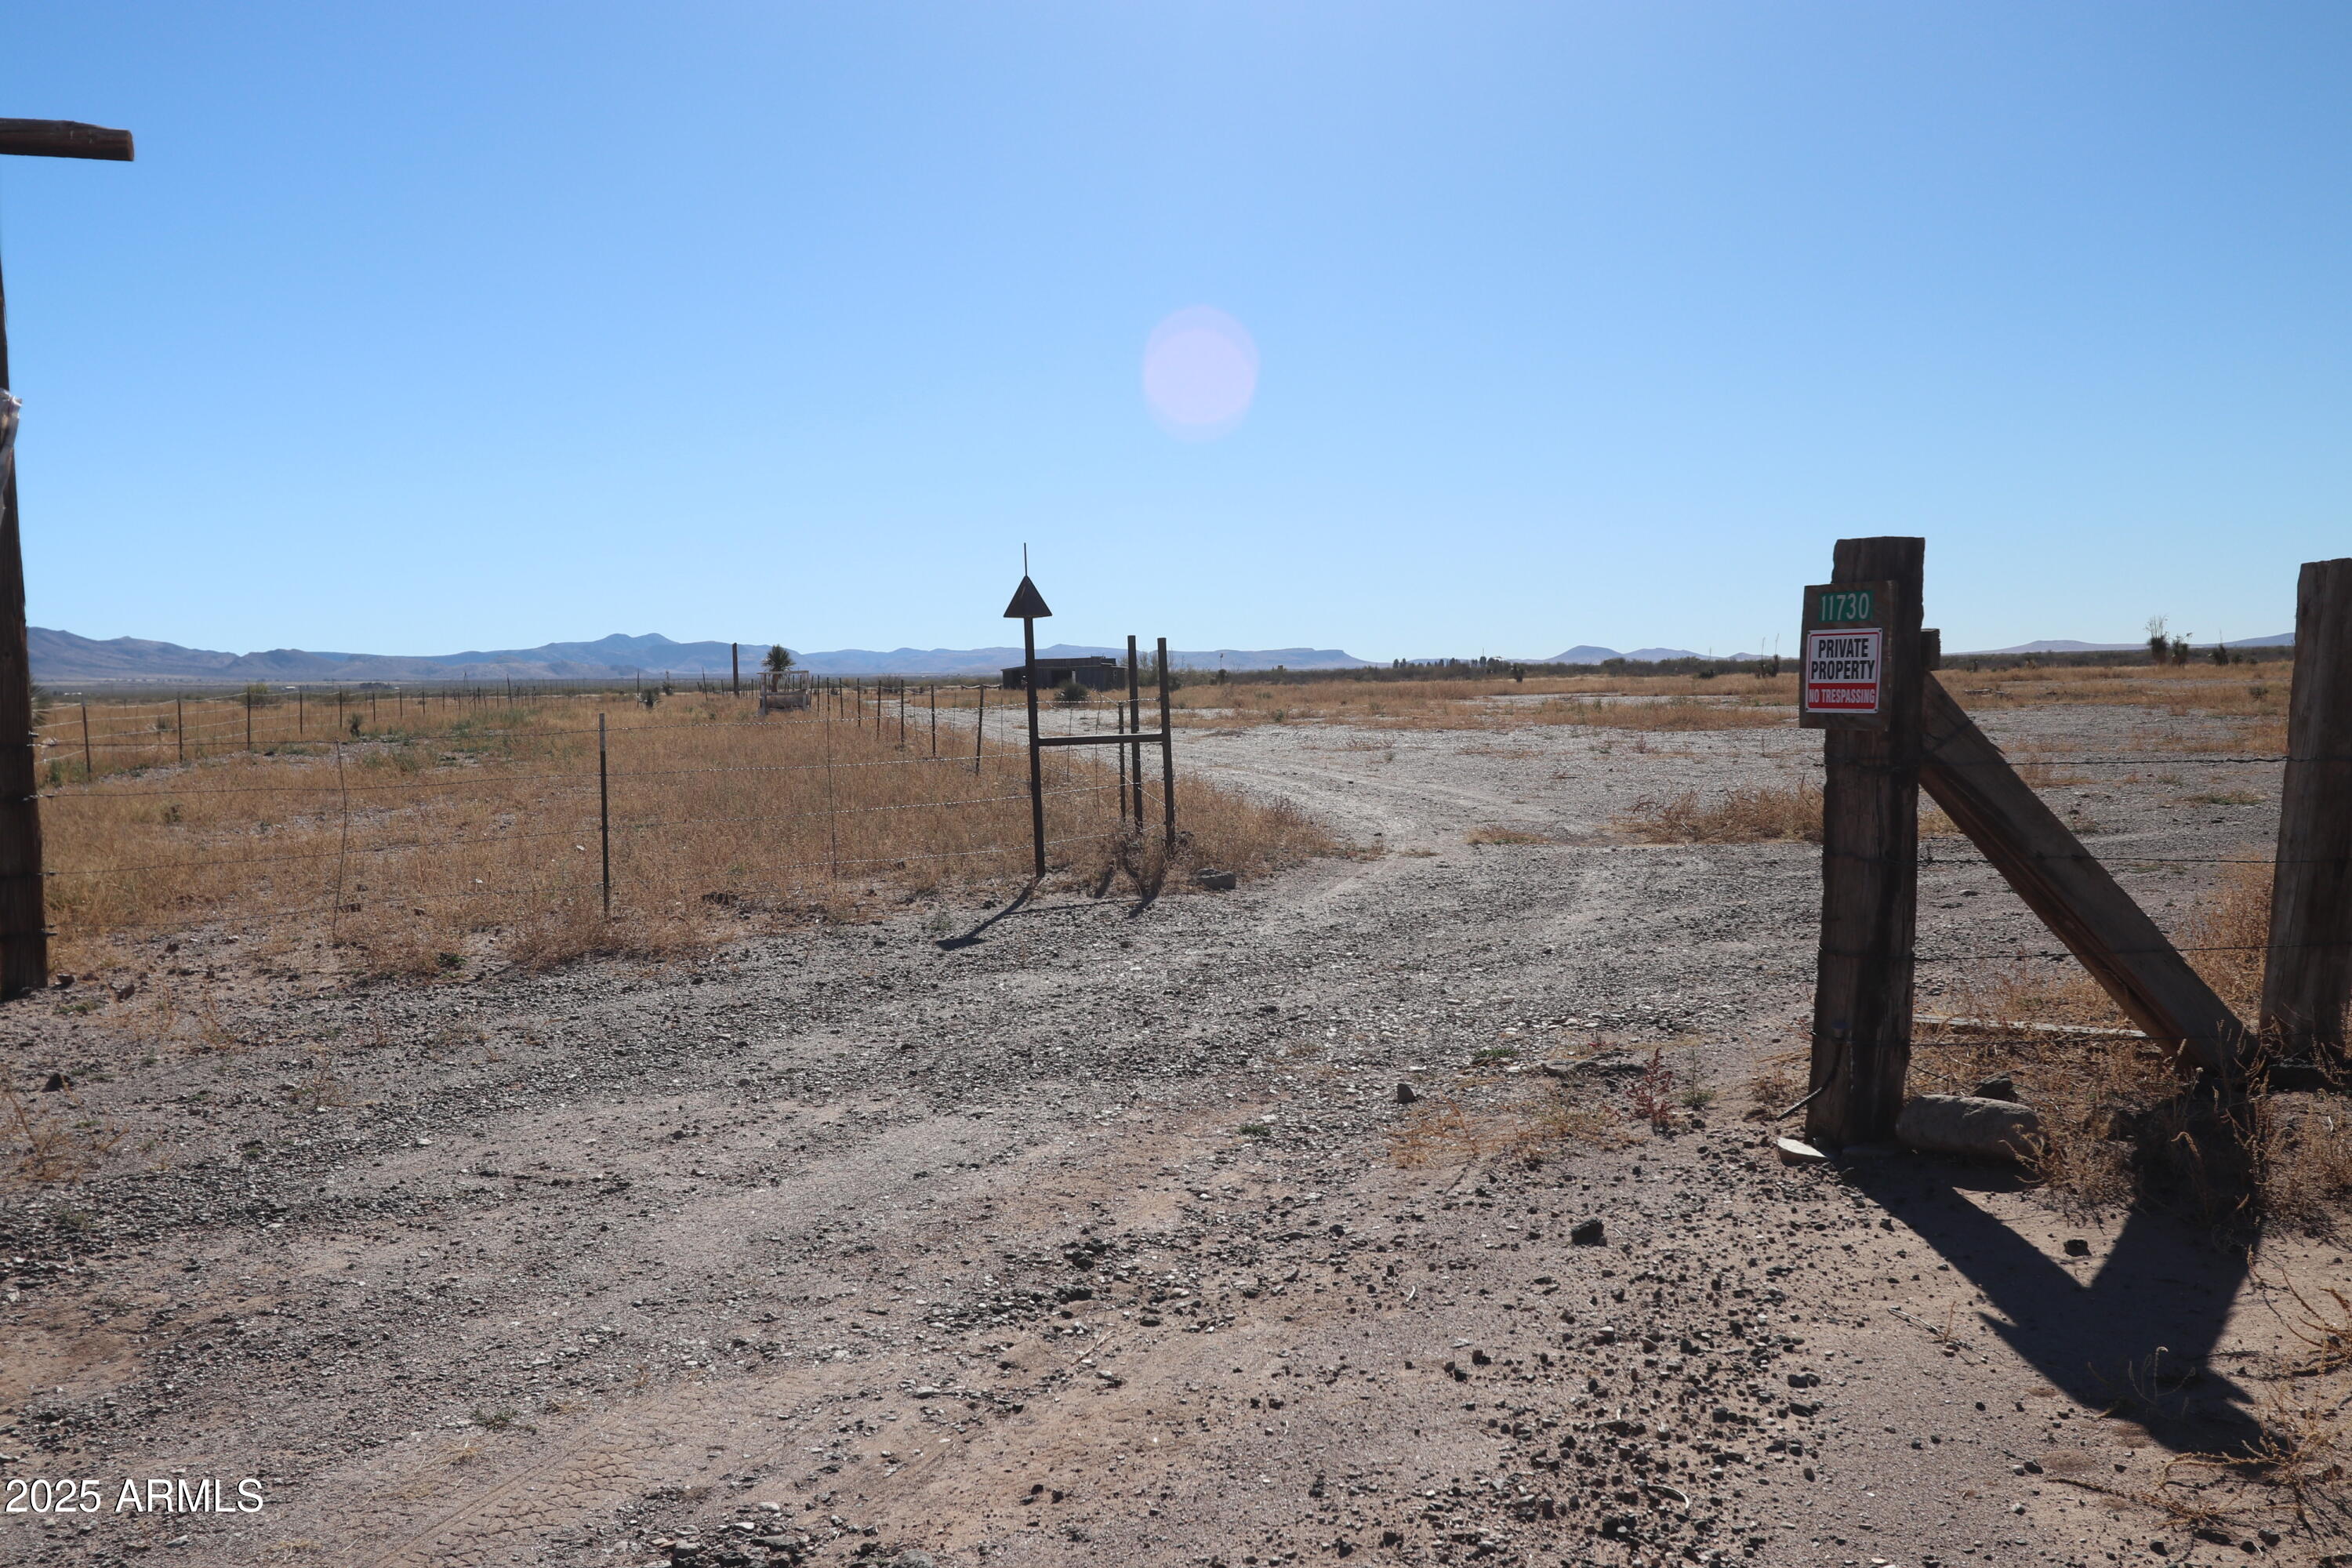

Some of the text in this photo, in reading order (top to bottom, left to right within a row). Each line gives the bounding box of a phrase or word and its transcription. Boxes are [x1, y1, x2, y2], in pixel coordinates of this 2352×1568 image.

[1821, 593, 1869, 620] 11730
[1818, 638, 1869, 658] PRIVATE
[1811, 660, 1875, 680] PROPERTY
[1809, 688, 1875, 703] NO TRESPASSING
